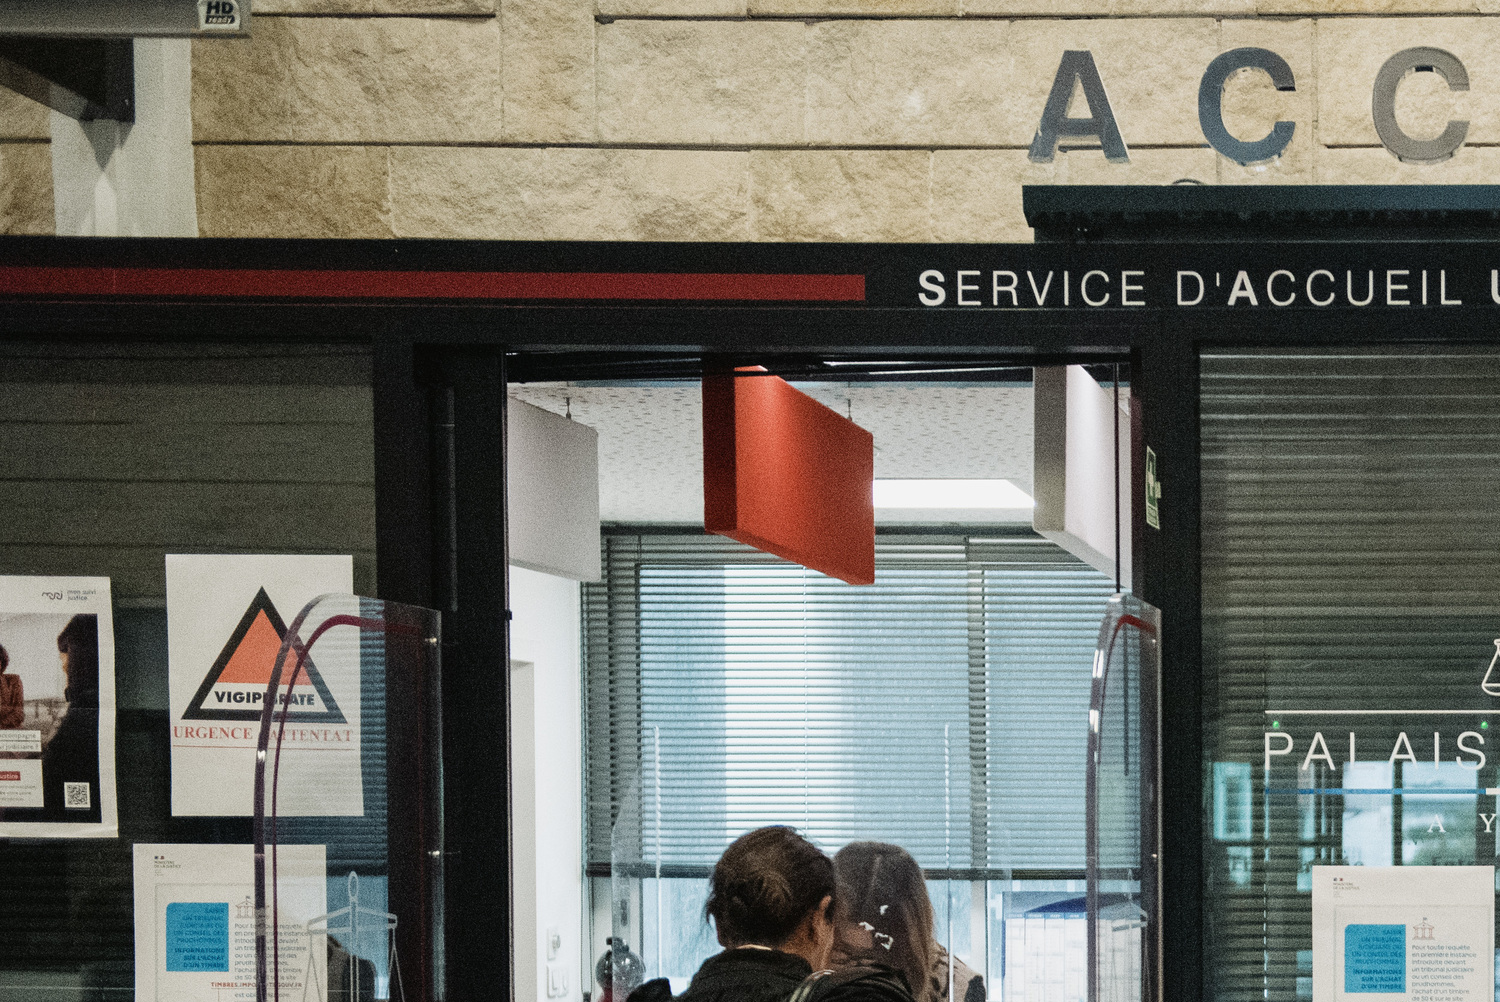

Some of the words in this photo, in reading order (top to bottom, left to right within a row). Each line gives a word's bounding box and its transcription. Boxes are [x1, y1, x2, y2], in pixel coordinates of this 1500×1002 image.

[206, 1, 234, 14] HD
[917, 268, 1146, 306] SERVICE
[1176, 268, 1463, 306] D'ACCUEIL
[173, 726, 253, 740] URGENCE
[269, 729, 353, 742] ATTENTAT
[1264, 730, 1487, 771] PALAIS
